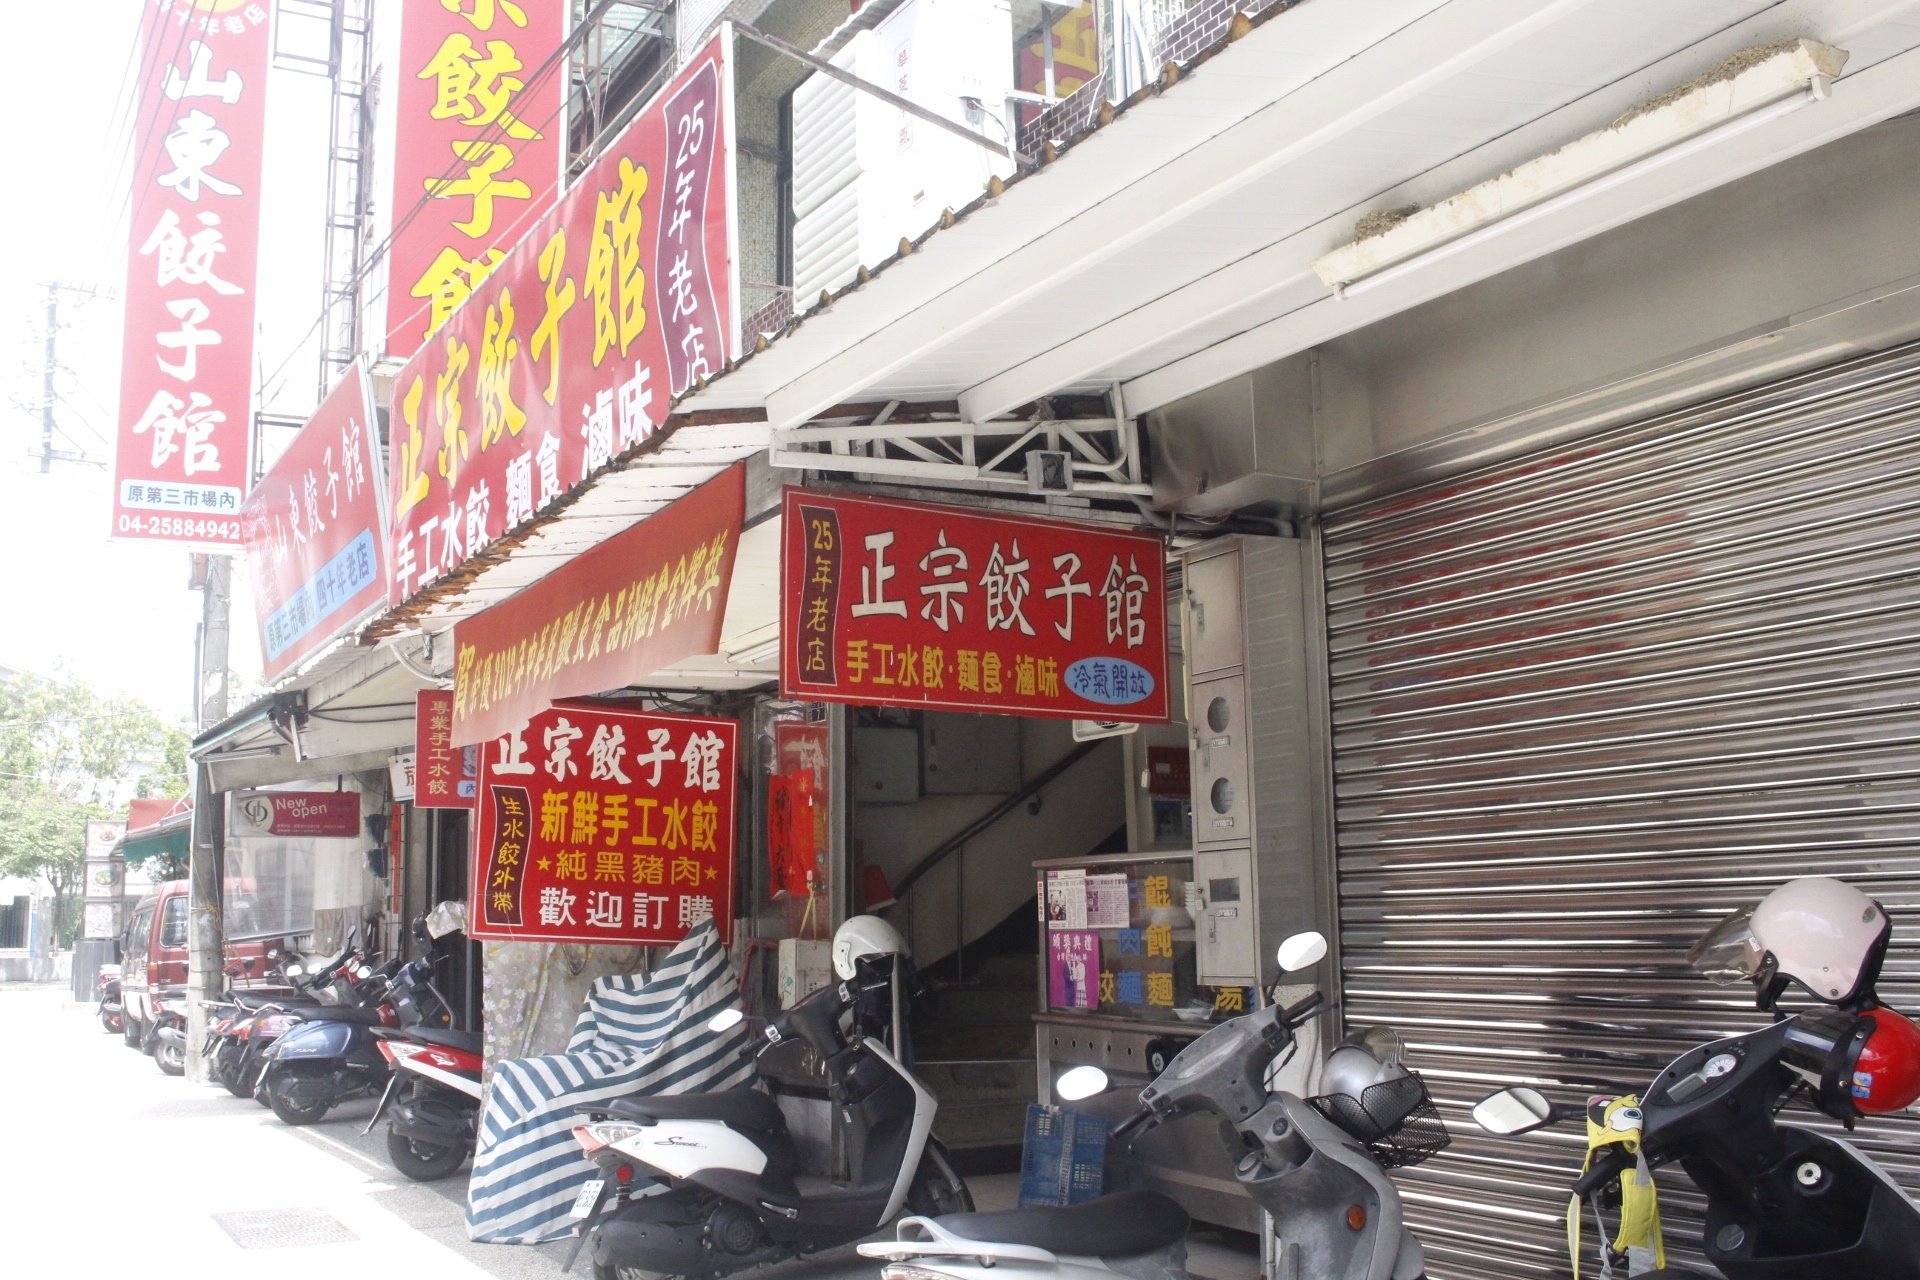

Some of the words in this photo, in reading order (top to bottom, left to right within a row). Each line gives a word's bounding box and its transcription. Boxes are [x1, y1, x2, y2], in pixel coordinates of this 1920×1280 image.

[133, 39, 245, 476] 山東餃子館
[669, 103, 711, 388] 25年老店
[396, 156, 649, 523] 正宗餃子館
[580, 360, 655, 481] 滷味
[118, 514, 241, 540] 04-25884942
[127, 484, 237, 509] 原第三市場內
[272, 417, 365, 564] 山東餃子館
[505, 430, 563, 529] 麵食
[316, 542, 370, 613] 四十年老店
[396, 478, 490, 597] 手工水餃
[805, 519, 833, 672] 25年老店
[850, 527, 1150, 650] 正宗餃子館
[1072, 663, 1148, 700] 冷氣開放
[427, 700, 451, 795] 專業手工水餃
[491, 717, 725, 793] 正宗餃子館
[275, 797, 307, 811] New
[292, 803, 328, 819] open
[540, 788, 718, 853] 新鮮手工水餃
[492, 795, 525, 912] 生水餃外帶
[555, 849, 701, 887] 純黑豬肉
[538, 887, 714, 930] 歡迎訂購
[1143, 875, 1175, 1007] 餛飩麵
